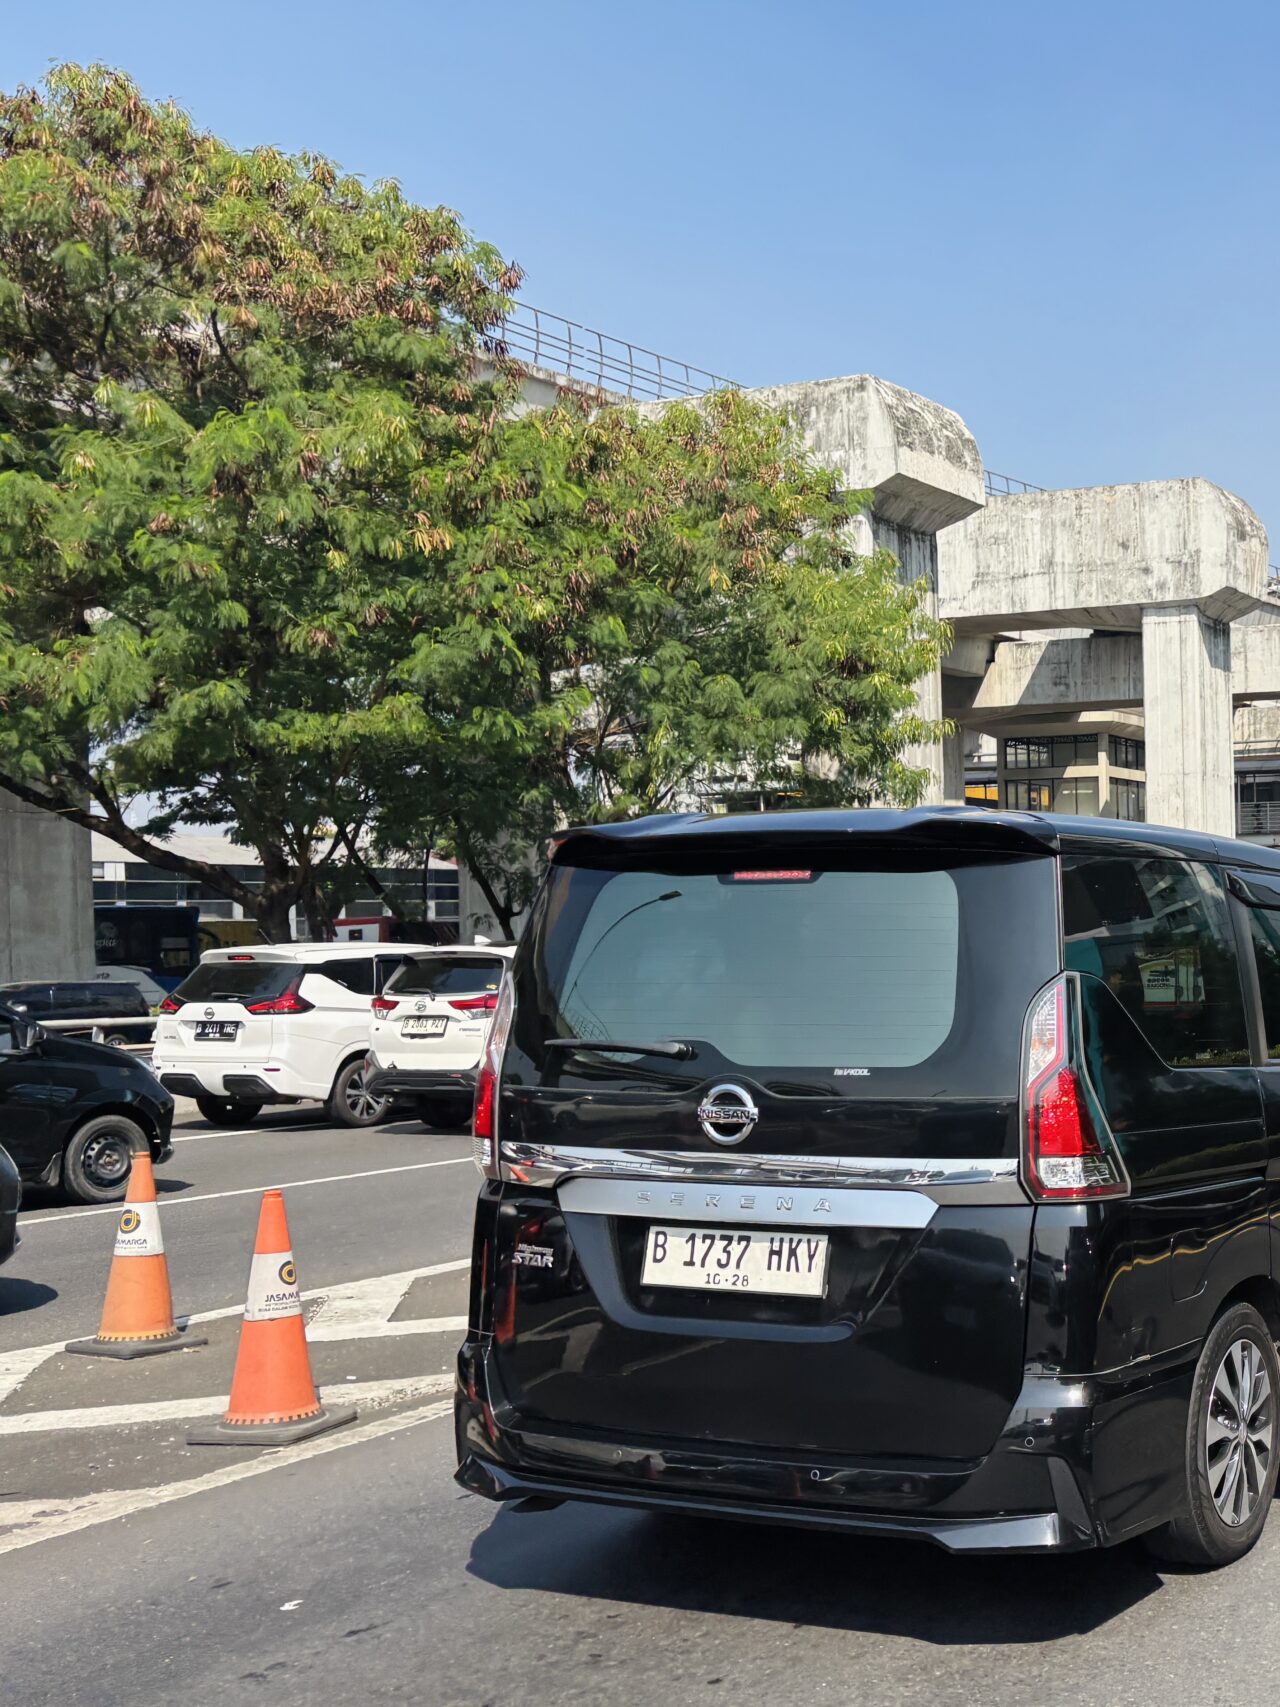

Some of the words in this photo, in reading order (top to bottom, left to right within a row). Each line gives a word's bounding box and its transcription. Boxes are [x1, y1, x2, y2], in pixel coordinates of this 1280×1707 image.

[196, 1023, 202, 1033] B
[702, 1108, 751, 1121] NISSAN
[636, 1191, 832, 1213] SERENA
[653, 1230, 667, 1263] B
[682, 1233, 752, 1269] 1737
[767, 1237, 820, 1273] HKY
[511, 1252, 554, 1268] STAR
